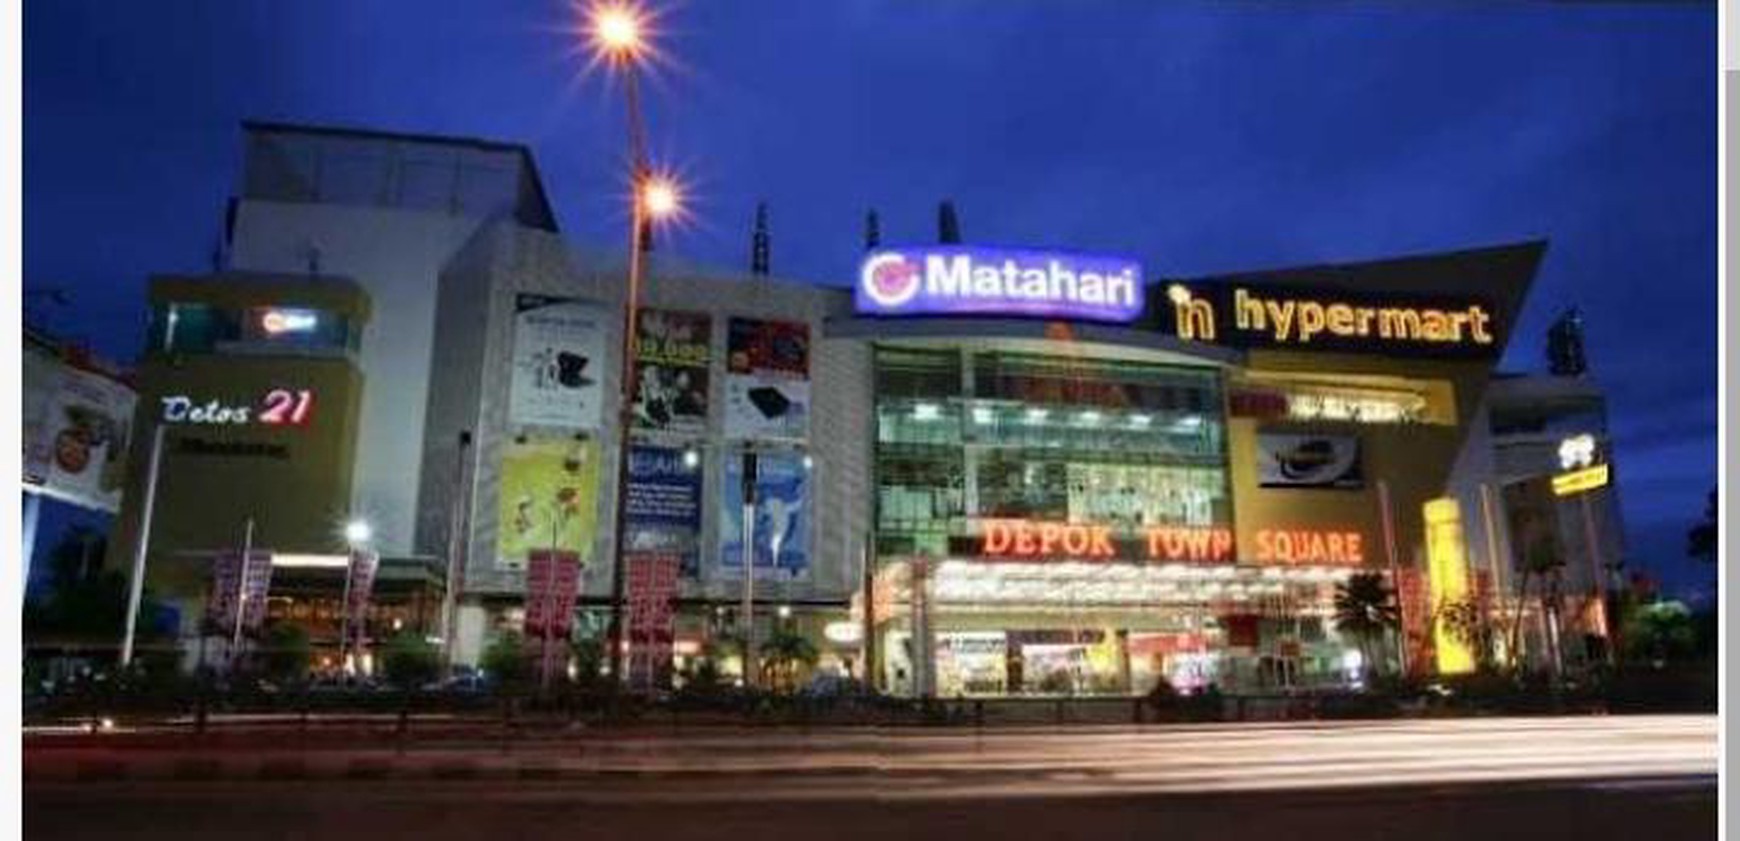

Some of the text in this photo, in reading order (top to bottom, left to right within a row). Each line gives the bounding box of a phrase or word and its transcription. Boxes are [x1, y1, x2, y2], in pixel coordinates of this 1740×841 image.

[925, 253, 1136, 308] Matahari
[1235, 288, 1492, 345] hypermart
[161, 388, 312, 424] Detos 21
[983, 524, 1362, 563] DEPOK TOWN SQUARE
